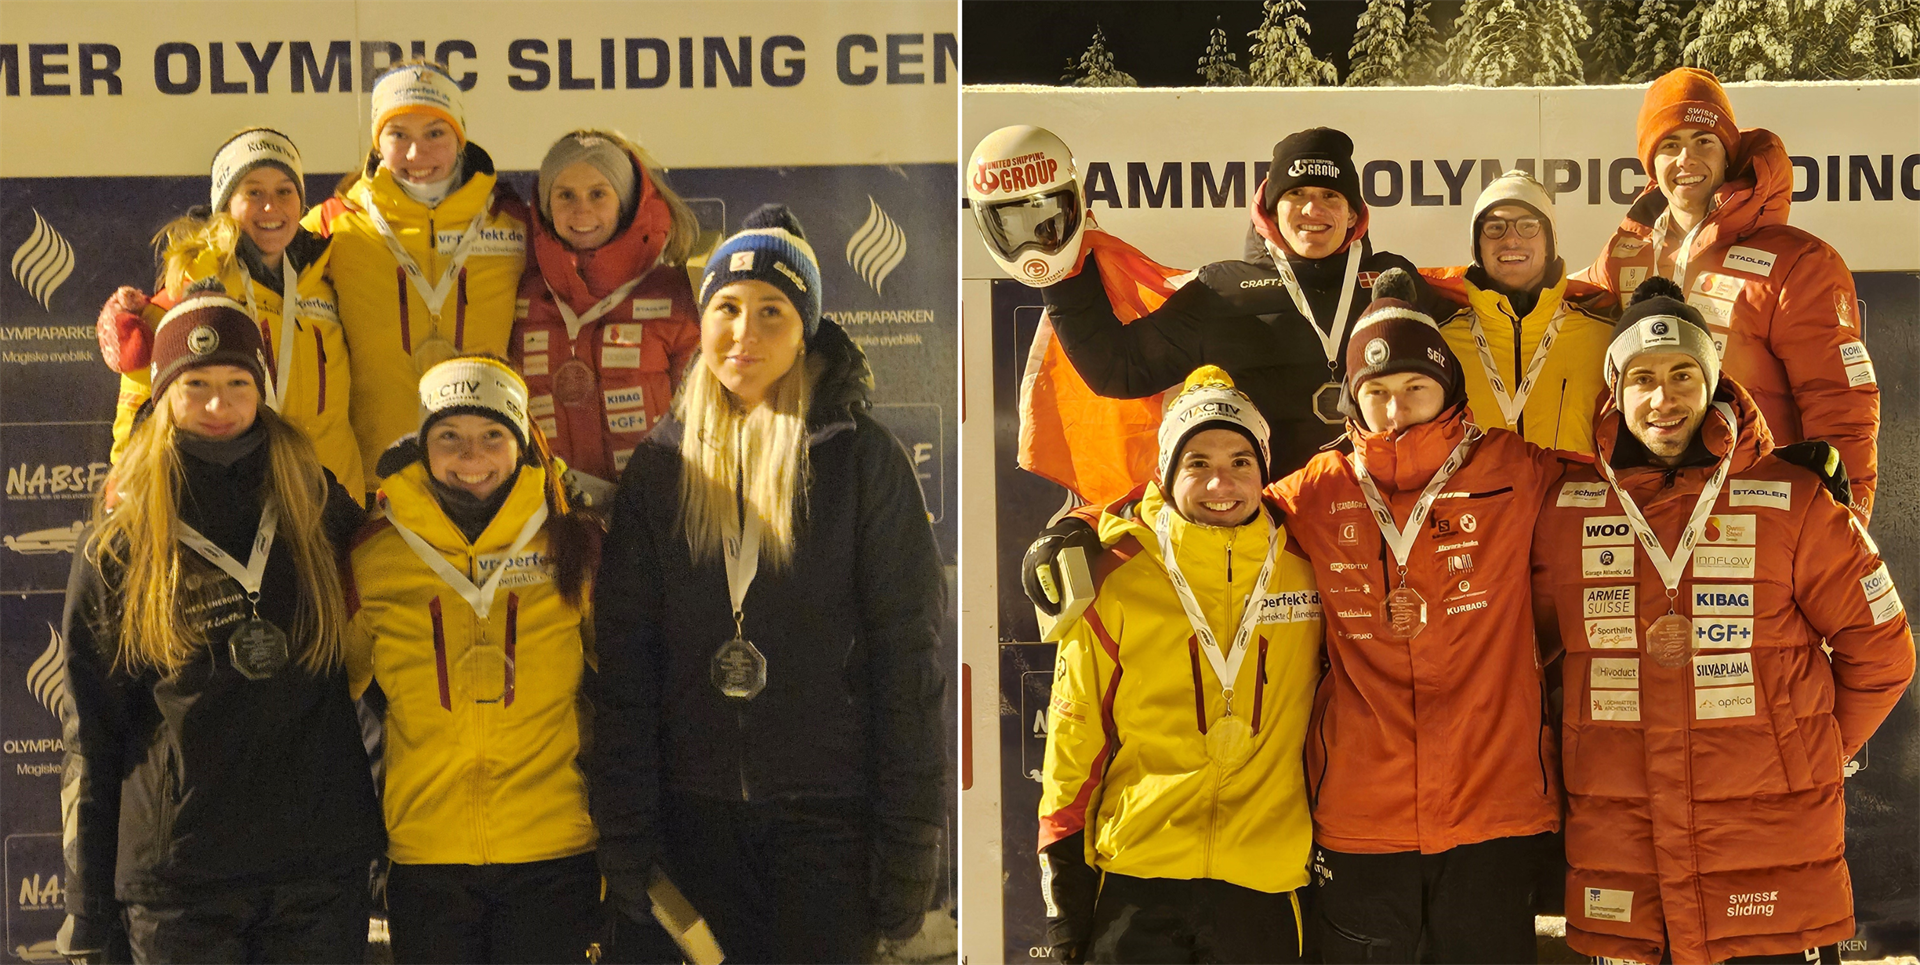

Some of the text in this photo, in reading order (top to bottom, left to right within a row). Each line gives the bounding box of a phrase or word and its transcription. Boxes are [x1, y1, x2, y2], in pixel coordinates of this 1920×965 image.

[508, 35, 806, 91] SLIDING
[985, 151, 1046, 170] UNITED SHIPPING
[1000, 158, 1058, 193] GROUP
[1307, 164, 1341, 179] GROUP
[1728, 253, 1773, 268] STADLER
[1239, 278, 1278, 289] CRAFT
[0, 326, 97, 340] LYMPIAPARKE
[2, 350, 49, 365] Magiske
[1426, 346, 1446, 368] SEIZ
[606, 393, 641, 405] KIBAG
[1179, 402, 1241, 424] VIACTIV
[1573, 488, 1606, 497] schmidt
[1732, 488, 1788, 500] STADLER
[1585, 523, 1630, 538] WOO
[1587, 589, 1631, 602] ARMEE
[1696, 593, 1749, 607] KIBAG
[1446, 600, 1488, 615] KURBADS
[1588, 601, 1631, 615] SUISSE
[1597, 626, 1633, 636] Sporthilfe
[1696, 661, 1750, 677] SILVAPLANA
[1718, 695, 1753, 708] aprico
[16, 763, 62, 777] Magiske
[1728, 892, 1771, 904] swiss
[1726, 903, 1775, 917] sliding
